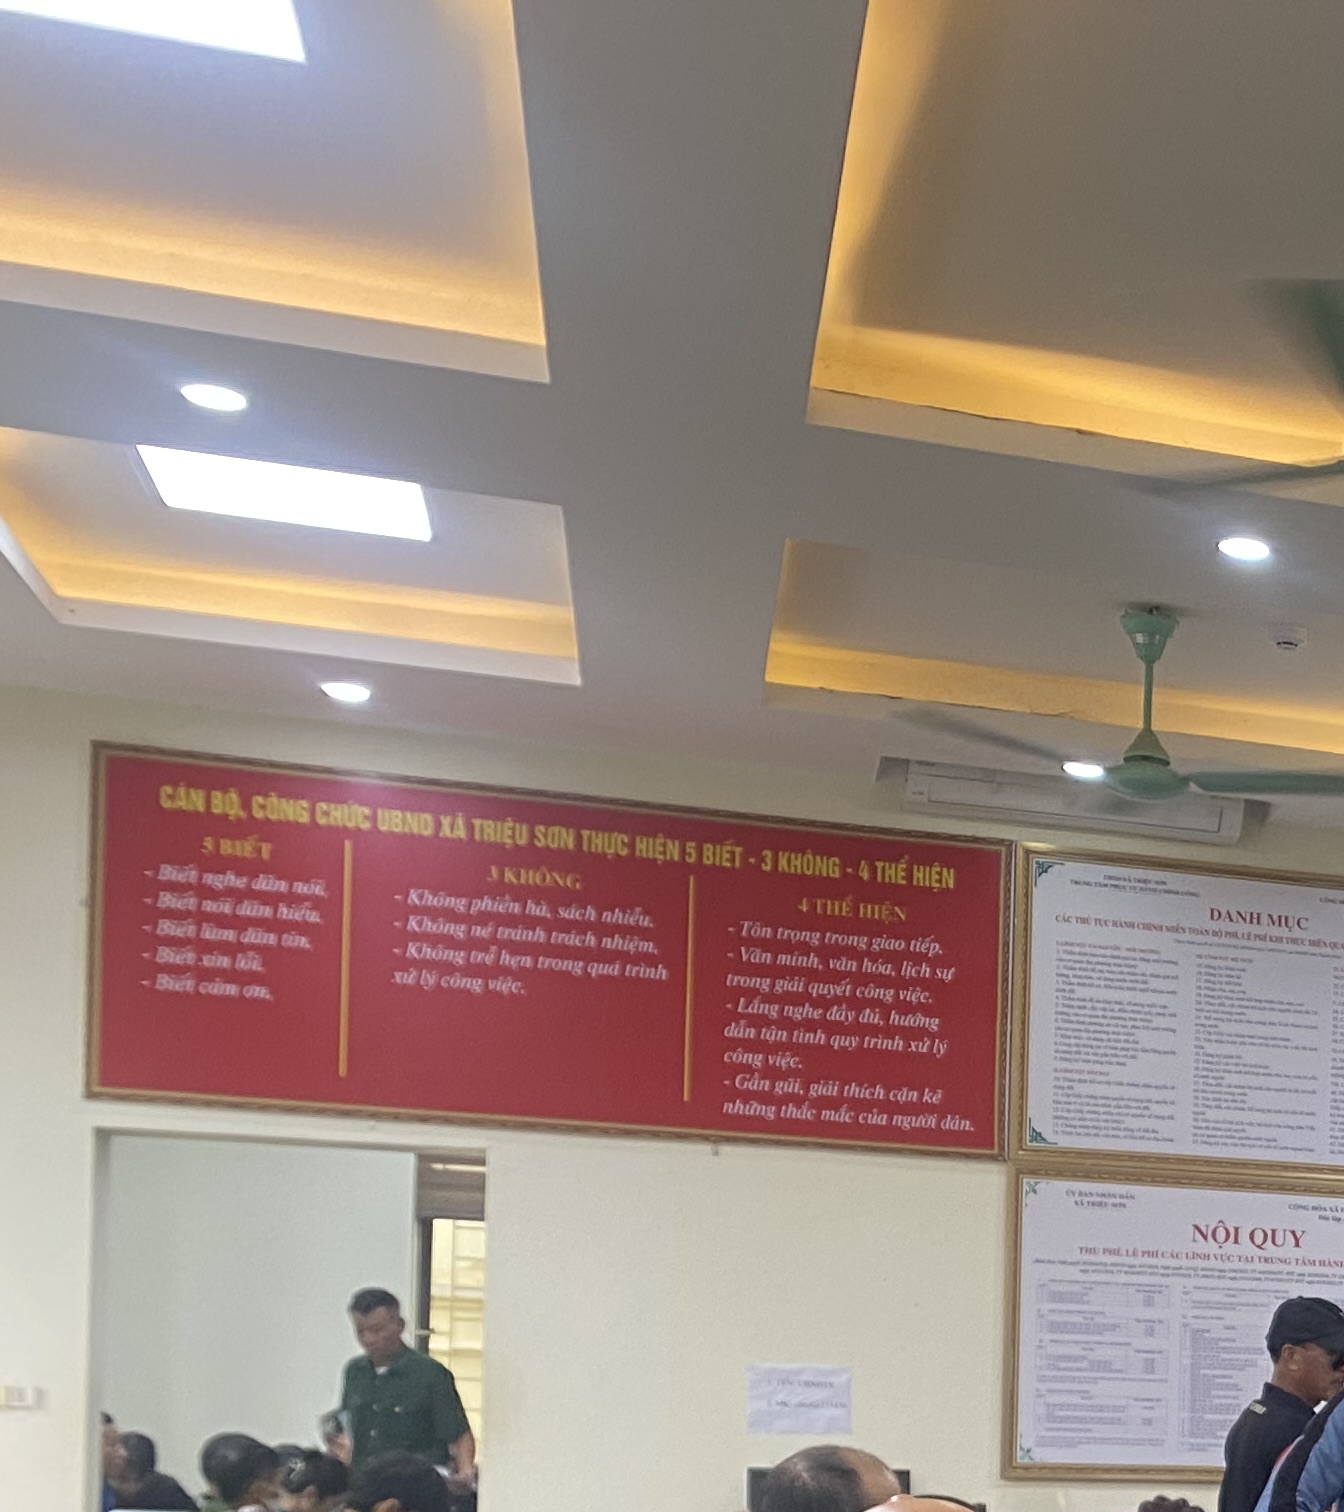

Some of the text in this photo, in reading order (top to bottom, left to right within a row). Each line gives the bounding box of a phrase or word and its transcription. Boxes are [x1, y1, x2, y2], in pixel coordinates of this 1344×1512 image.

[252, 792, 310, 824] CÔNG
[315, 799, 371, 830] CHỨC
[377, 807, 434, 836] UBND
[472, 817, 529, 848] TRIỆU
[534, 825, 575, 850] SƠN
[581, 829, 629, 859] THỰC
[636, 834, 680, 863] HIỆN
[686, 842, 696, 863] 5
[702, 839, 743, 868] BIẾT
[761, 850, 772, 872] 3
[778, 850, 840, 878] KHÔNG
[858, 860, 869, 881] 4
[875, 855, 909, 885] THỂ
[912, 862, 955, 892] HIỆN
[798, 897, 808, 913] 4
[859, 899, 907, 924] HIỆN
[1210, 907, 1309, 932] DANH MỤC
[740, 921, 943, 957] Tôn trọng trong giao tiếp.
[740, 946, 955, 984] Văn minh, văn hóa, lịch sự
[726, 973, 932, 1004] trong giải quyết công việc.
[737, 996, 940, 1032] Lắng nghe đầy đủ, hướng
[724, 1020, 949, 1058] dẫn tận tình quy trình xử lý
[735, 1072, 770, 1092] Gần
[808, 1080, 838, 1098] giải
[843, 1081, 884, 1100] thích
[889, 1086, 917, 1104] cặn
[922, 1088, 943, 1104] kẽ
[722, 1099, 974, 1132] những thắc mắc của người dân.
[1192, 1219, 1306, 1250] NỘI QUY
